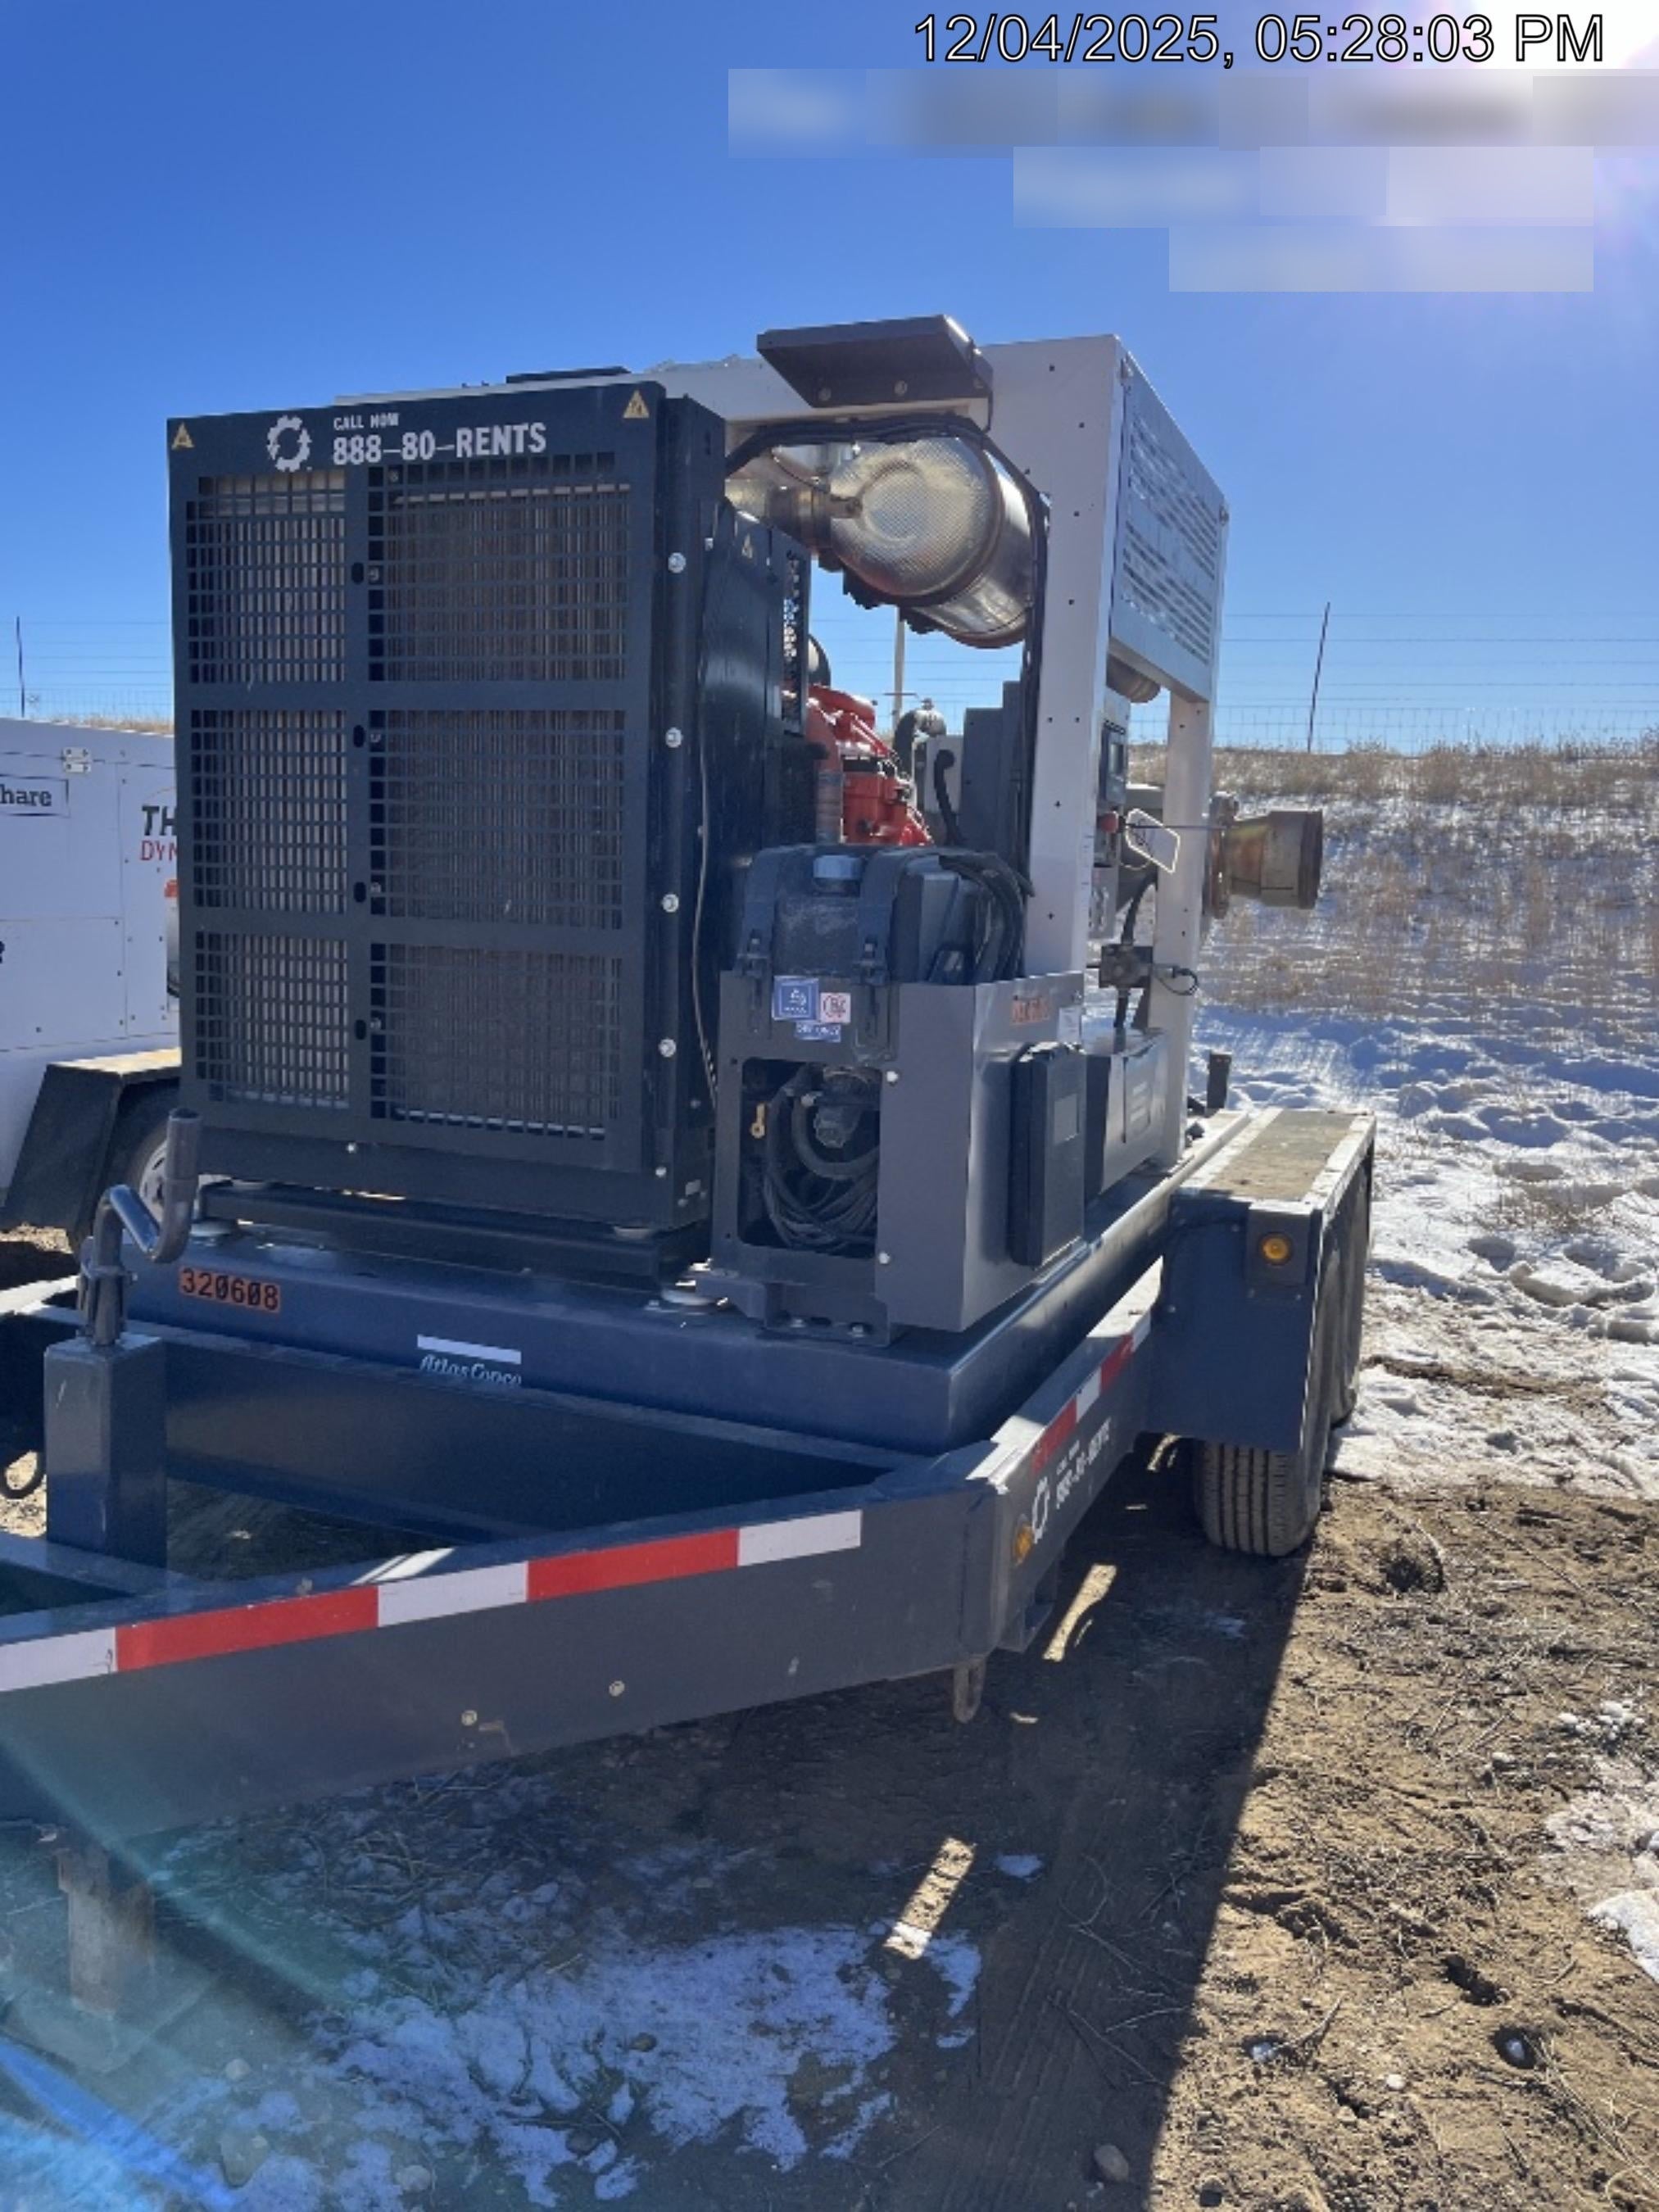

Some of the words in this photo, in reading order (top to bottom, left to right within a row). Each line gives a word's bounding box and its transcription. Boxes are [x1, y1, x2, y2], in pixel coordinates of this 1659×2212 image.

[333, 415, 365, 431] CALL
[370, 412, 401, 428] NOW
[333, 422, 547, 466] 888-80-RENTS
[181, 1267, 280, 1311] 320608
